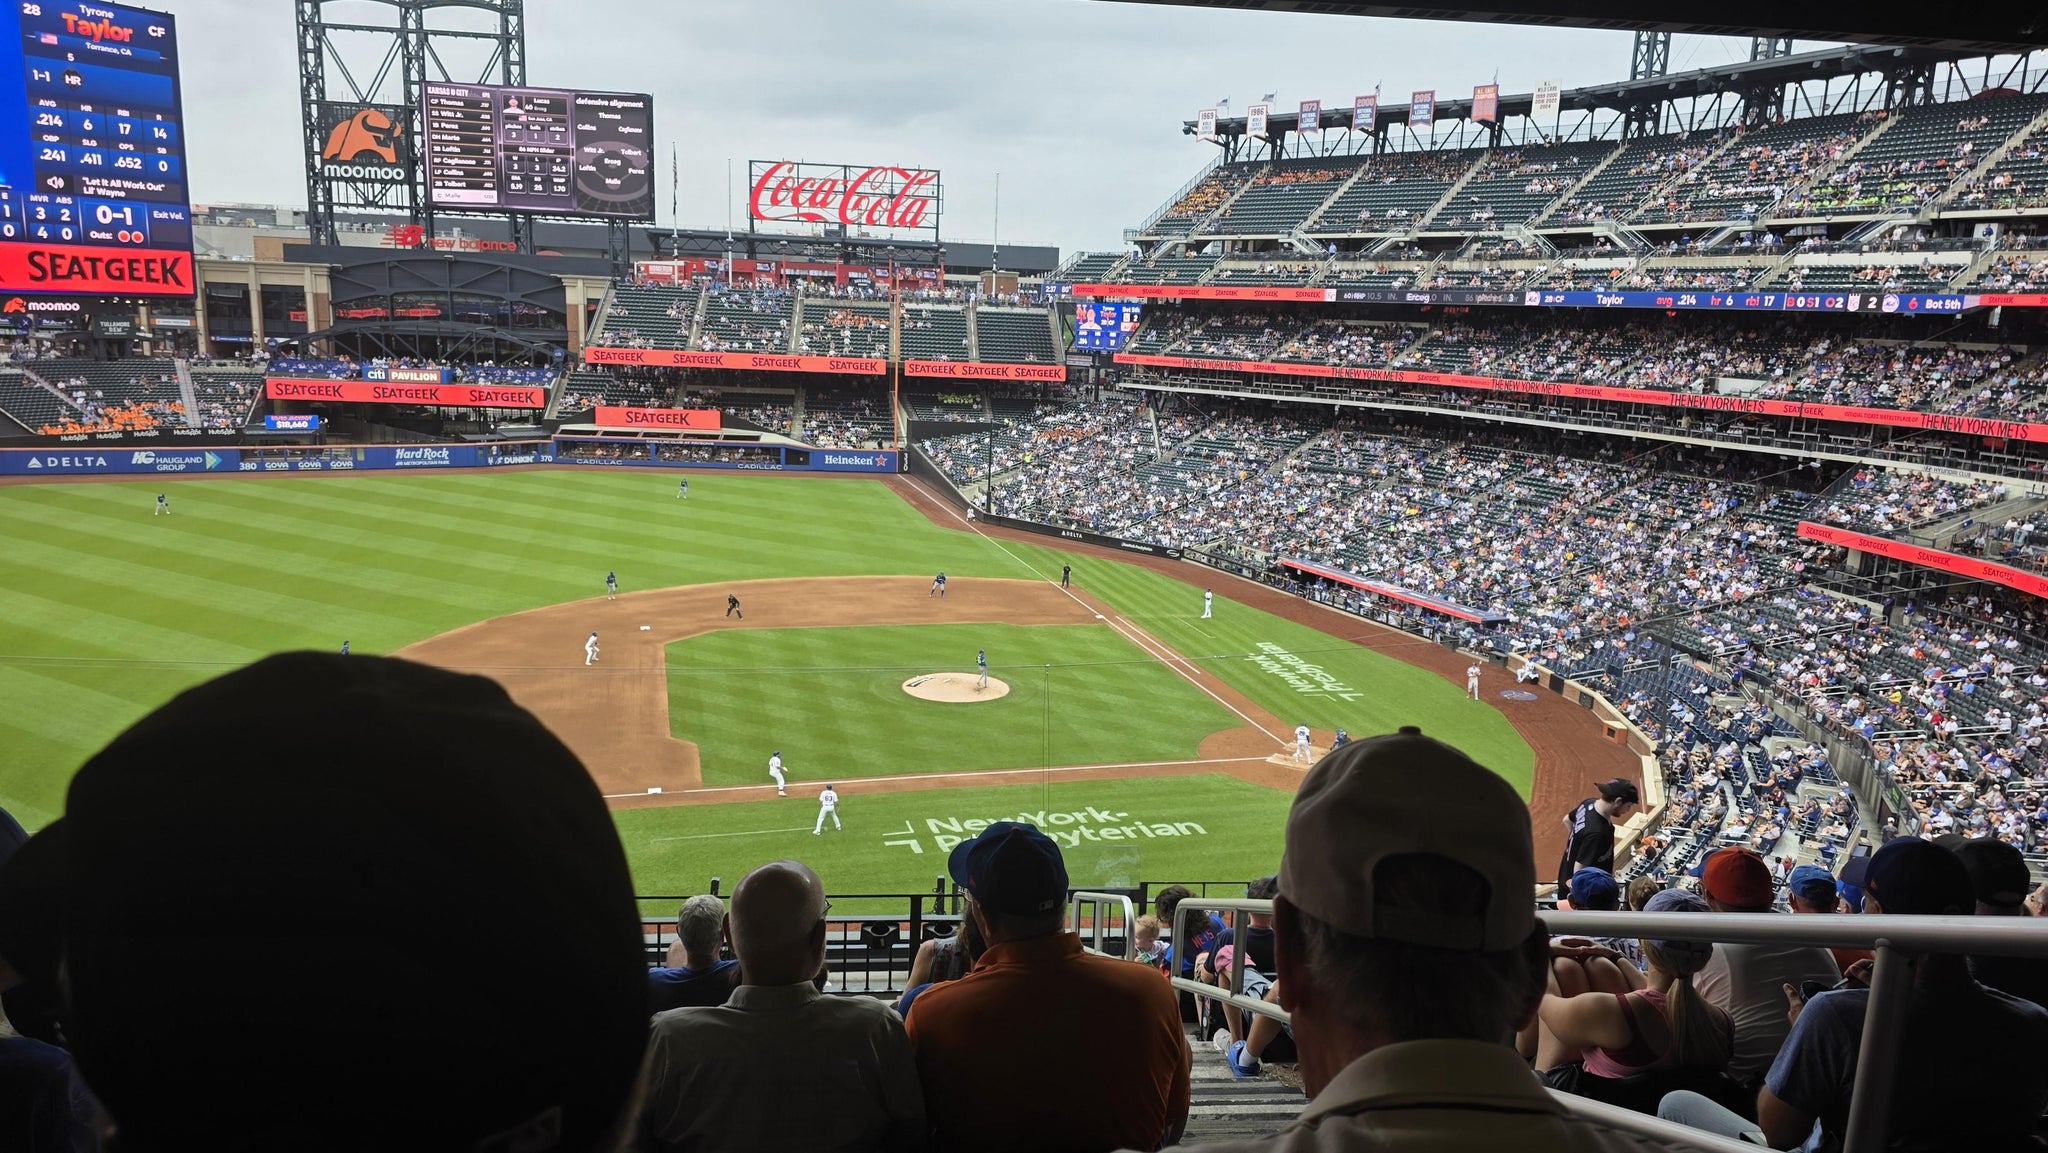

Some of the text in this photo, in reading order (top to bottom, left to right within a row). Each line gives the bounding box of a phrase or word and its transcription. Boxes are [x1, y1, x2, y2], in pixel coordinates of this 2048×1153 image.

[23, 3, 41, 16] 28
[79, 4, 114, 19] Tyrone
[60, 12, 134, 42] Taylor
[148, 26, 166, 37] CF
[85, 42, 132, 57] Torrance, CA
[67, 53, 75, 62] 5
[32, 69, 50, 82] 1-1
[65, 74, 82, 86] HR
[38, 99, 57, 108] AVG
[80, 104, 92, 113] HR
[576, 97, 644, 108] defensive alignment
[117, 109, 130, 117] RBI
[36, 113, 63, 128] .214
[83, 119, 93, 131] 6
[118, 123, 131, 135] 17
[153, 127, 168, 139] 14
[42, 134, 60, 142] OBP
[82, 139, 98, 147] SLG
[119, 143, 135, 151] OPS
[40, 149, 66, 162] .241
[80, 153, 102, 166] .411
[114, 157, 142, 170] .652
[158, 160, 168, 172] 0
[604, 158, 621, 166] Erceg
[324, 164, 405, 180] moomoo
[110, 179, 121, 188] All
[122, 181, 146, 190] Work
[30, 194, 49, 203] MVR
[96, 188, 126, 199] Wayne
[56, 196, 73, 205] ABS
[3, 204, 11, 218] 1
[35, 206, 46, 220] 3
[60, 208, 71, 221] 2
[96, 205, 133, 226] 0-1
[153, 211, 184, 221] Exit Vel.
[3, 224, 15, 237] 0
[37, 226, 48, 239] 4
[61, 227, 72, 240] 0
[90, 230, 113, 240] Outs:
[428, 237, 516, 251] new balance
[27, 250, 186, 288] SEATGEEK
[28, 301, 80, 312] moomoo
[1544, 295, 1775, 307] 28 CF Taylor avg .214 hr 6 rbi 17
[1786, 298, 1795, 307] B
[1796, 297, 1805, 308] 0
[1834, 297, 1844, 308] 2
[1867, 296, 1878, 309] 2
[1908, 297, 1918, 309] 6
[1925, 299, 1961, 310] Bot 5th
[594, 351, 644, 362] SEATGEEK
[673, 354, 723, 365] SEATGEEK
[752, 356, 801, 368] SEATGEEK
[829, 360, 878, 372] SEATGEEK
[908, 363, 957, 375] SEATGEEK
[1182, 358, 1193, 367] THE
[1193, 359, 1207, 368] NEW
[1208, 360, 1225, 369] YORK
[1225, 361, 1243, 370] METS
[367, 369, 437, 382] citi PAVILION
[962, 366, 1009, 377] SEATGEEK
[1014, 367, 1062, 379] SEATGEEK
[1331, 367, 1344, 377] THE
[1345, 369, 1362, 379] NEW
[1363, 369, 1382, 380] YORK
[1384, 371, 1404, 381] METS
[275, 383, 344, 398] SEATGEEK
[1491, 379, 1504, 390] THE
[1505, 380, 1521, 391] NEW
[1521, 381, 1540, 393] YORK
[1542, 383, 1562, 394] METS
[373, 386, 441, 402] SEATGEEK
[469, 390, 536, 404] SEATGEEK
[1574, 388, 1602, 397] SEATGEEK
[1670, 394, 1687, 406] THE
[1687, 395, 1707, 408] NEW
[1711, 396, 1737, 410] YORK
[1738, 398, 1765, 413] METS
[626, 411, 690, 425] SEATGEEK
[276, 421, 308, 429] $18,660
[1921, 413, 1939, 429] THE
[1940, 415, 1964, 431] NEW
[1966, 418, 1994, 435] YORK
[1996, 422, 2029, 439] METS
[61, 433, 88, 441] HubSpot
[96, 431, 123, 439] HubSpot
[134, 429, 159, 437] HubSpot
[174, 428, 201, 436] HubSpot
[208, 428, 236, 436] HubSpot
[132, 452, 156, 464] HG
[156, 456, 202, 464] HAUGLAND
[396, 448, 449, 460] Hard Rock
[47, 457, 107, 467] DELTA
[239, 462, 257, 470] 380
[824, 455, 873, 466] Heineken
[1066, 531, 1083, 539] DELTA
[1806, 526, 1833, 540] SEATGEEK
[1859, 538, 1889, 552] SEATGEEK
[1917, 551, 1951, 566] SEATGEEK
[1982, 566, 2015, 583] SEATGEEK
